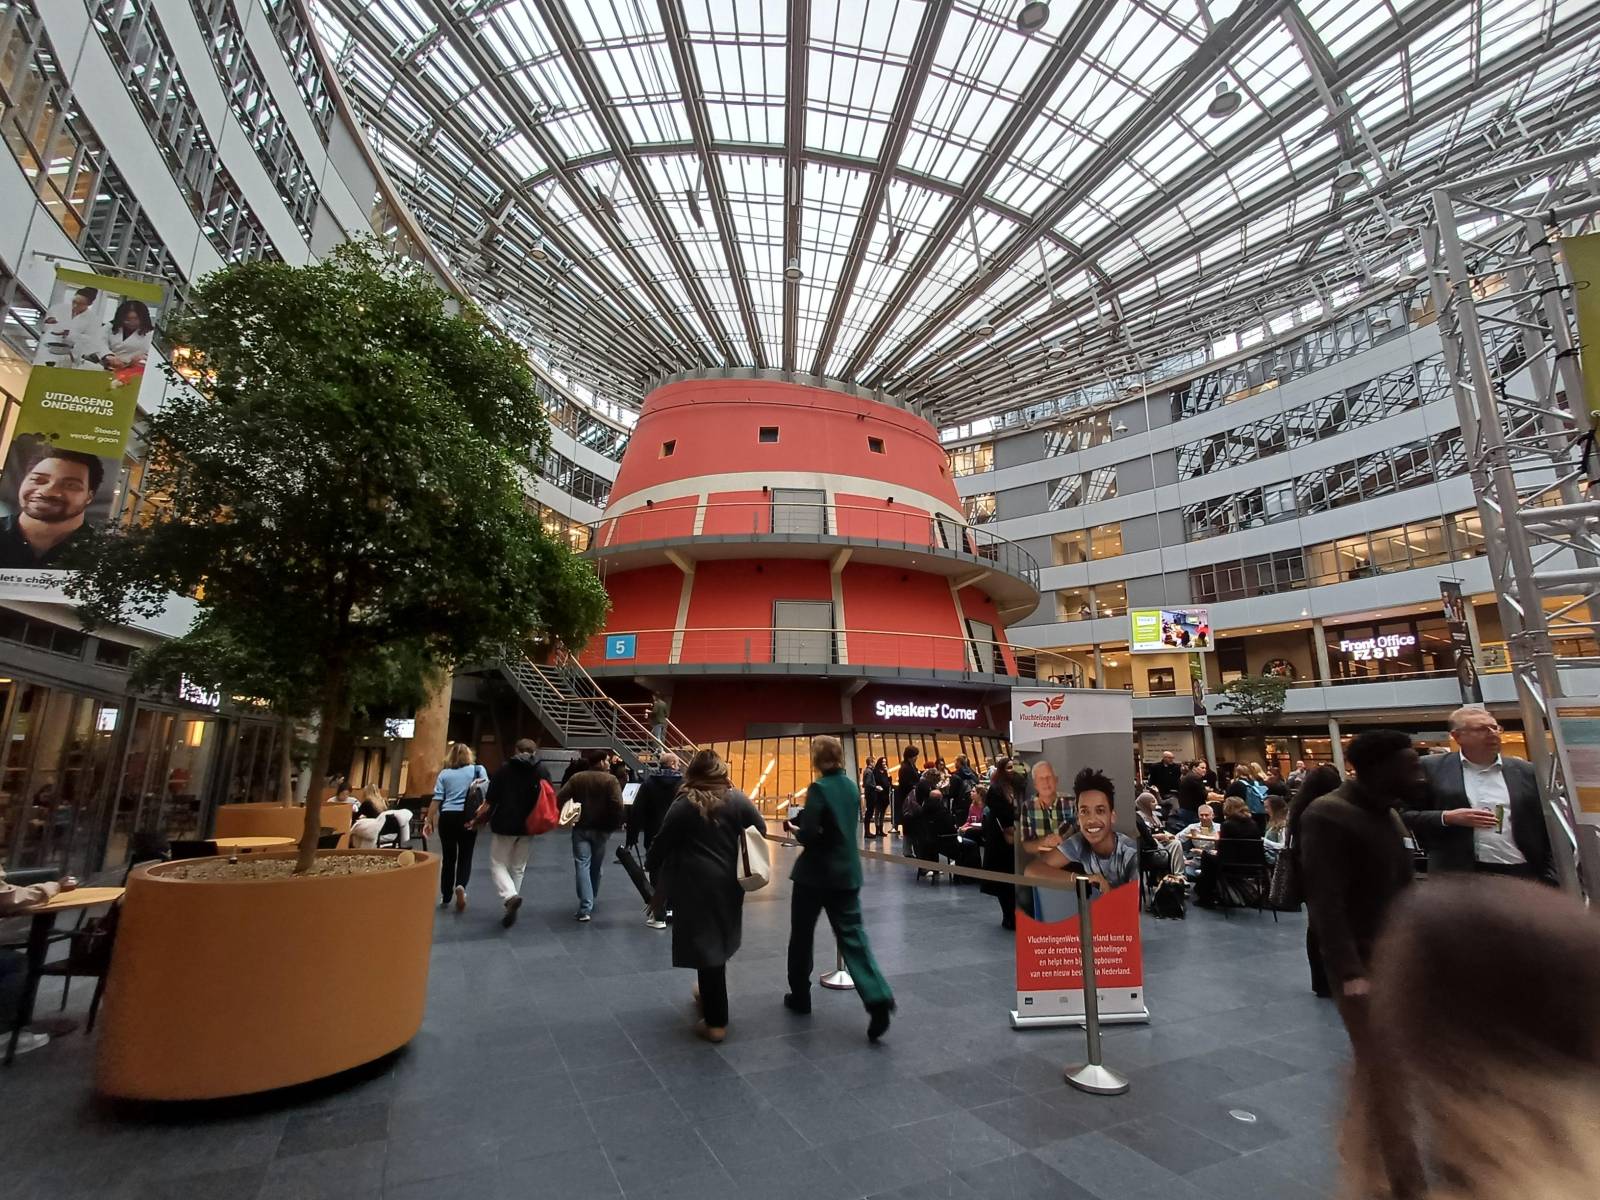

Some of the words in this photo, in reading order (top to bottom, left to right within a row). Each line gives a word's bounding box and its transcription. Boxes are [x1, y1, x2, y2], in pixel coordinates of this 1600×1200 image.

[45, 392, 114, 408] UITDAGEND
[41, 400, 114, 416] ONDERWIJS
[94, 426, 121, 436] Steeds
[70, 433, 96, 441] verder
[97, 436, 119, 444] gaan
[0, 574, 23, 582] let's
[616, 640, 625, 655] 5
[1340, 639, 1376, 652] Front
[1377, 634, 1416, 647] Office
[1353, 649, 1372, 661] FZ
[1373, 647, 1385, 659] &
[1386, 645, 1400, 657] IT
[941, 703, 978, 720] Corner
[1020, 713, 1069, 722] VluchtelingenWerk
[1126, 935, 1133, 943] op
[1047, 958, 1062, 967] helpt
[1094, 957, 1123, 966] opbouwen
[1094, 968, 1101, 976] in
[1101, 967, 1132, 976] Nederland.
